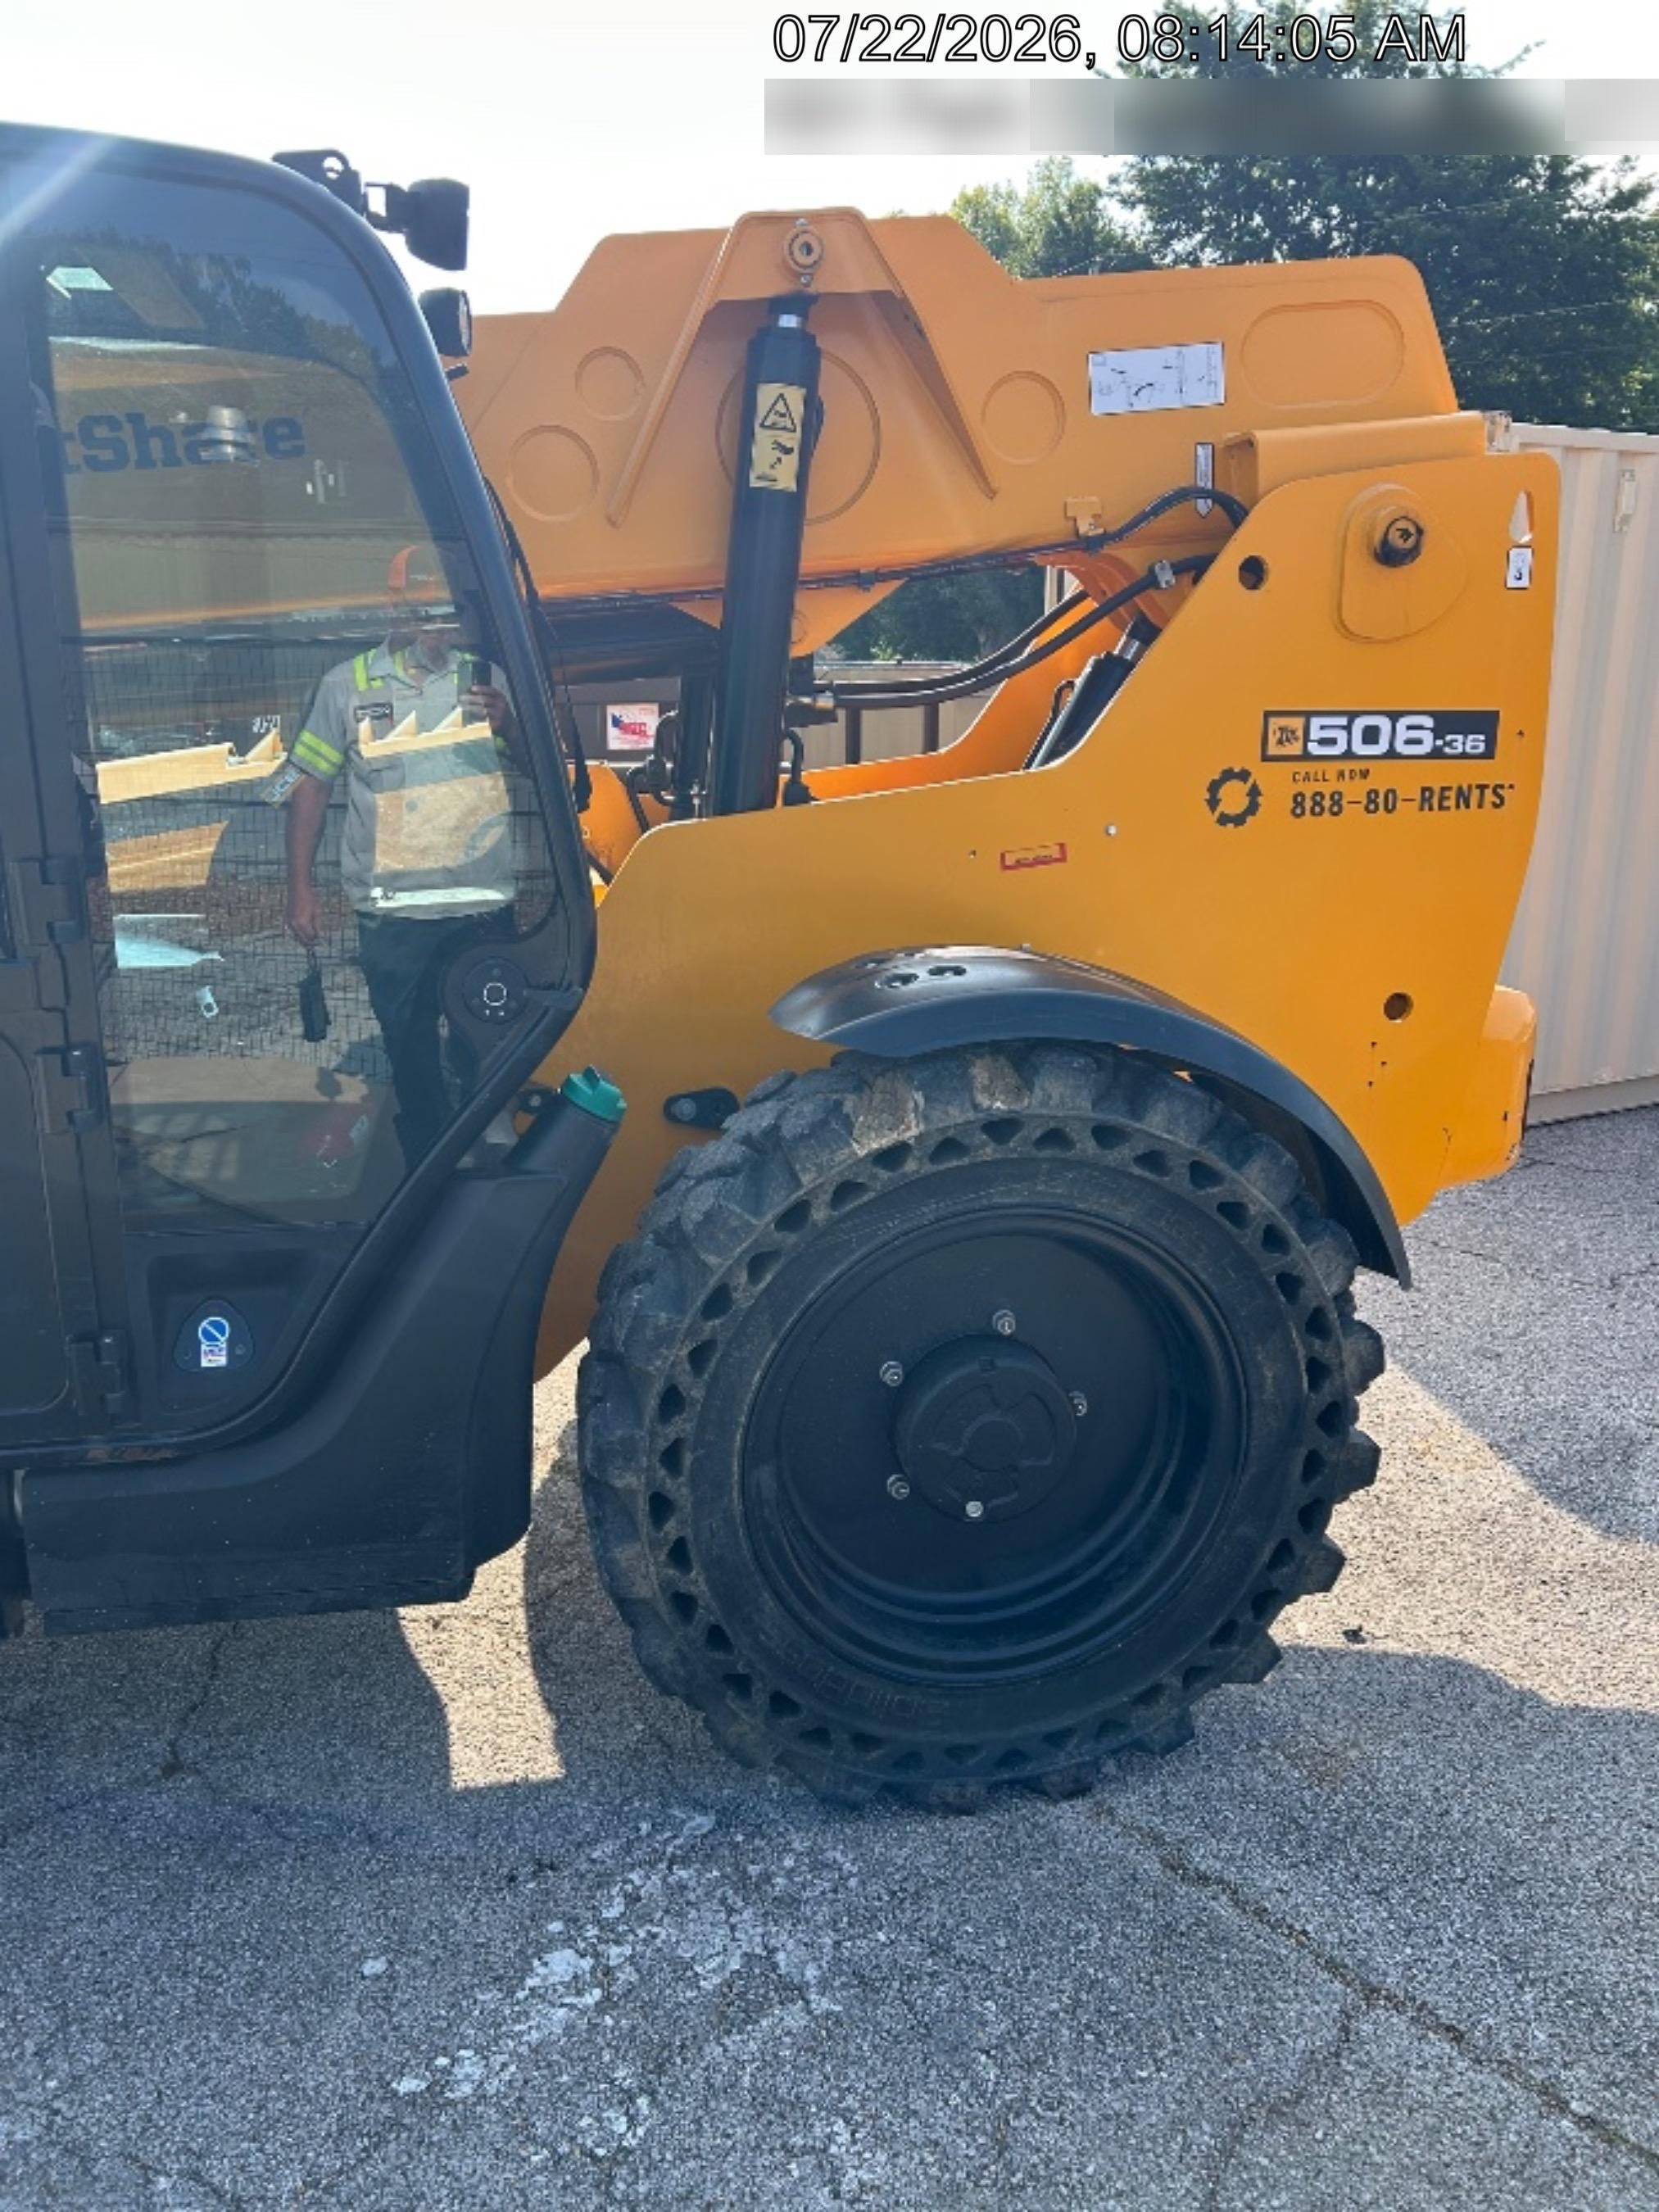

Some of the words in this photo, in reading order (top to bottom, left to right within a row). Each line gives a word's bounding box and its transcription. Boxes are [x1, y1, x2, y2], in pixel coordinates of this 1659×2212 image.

[1308, 714, 1485, 756] 506-36
[1292, 770, 1329, 783] CALL
[1337, 768, 1370, 782] NOW
